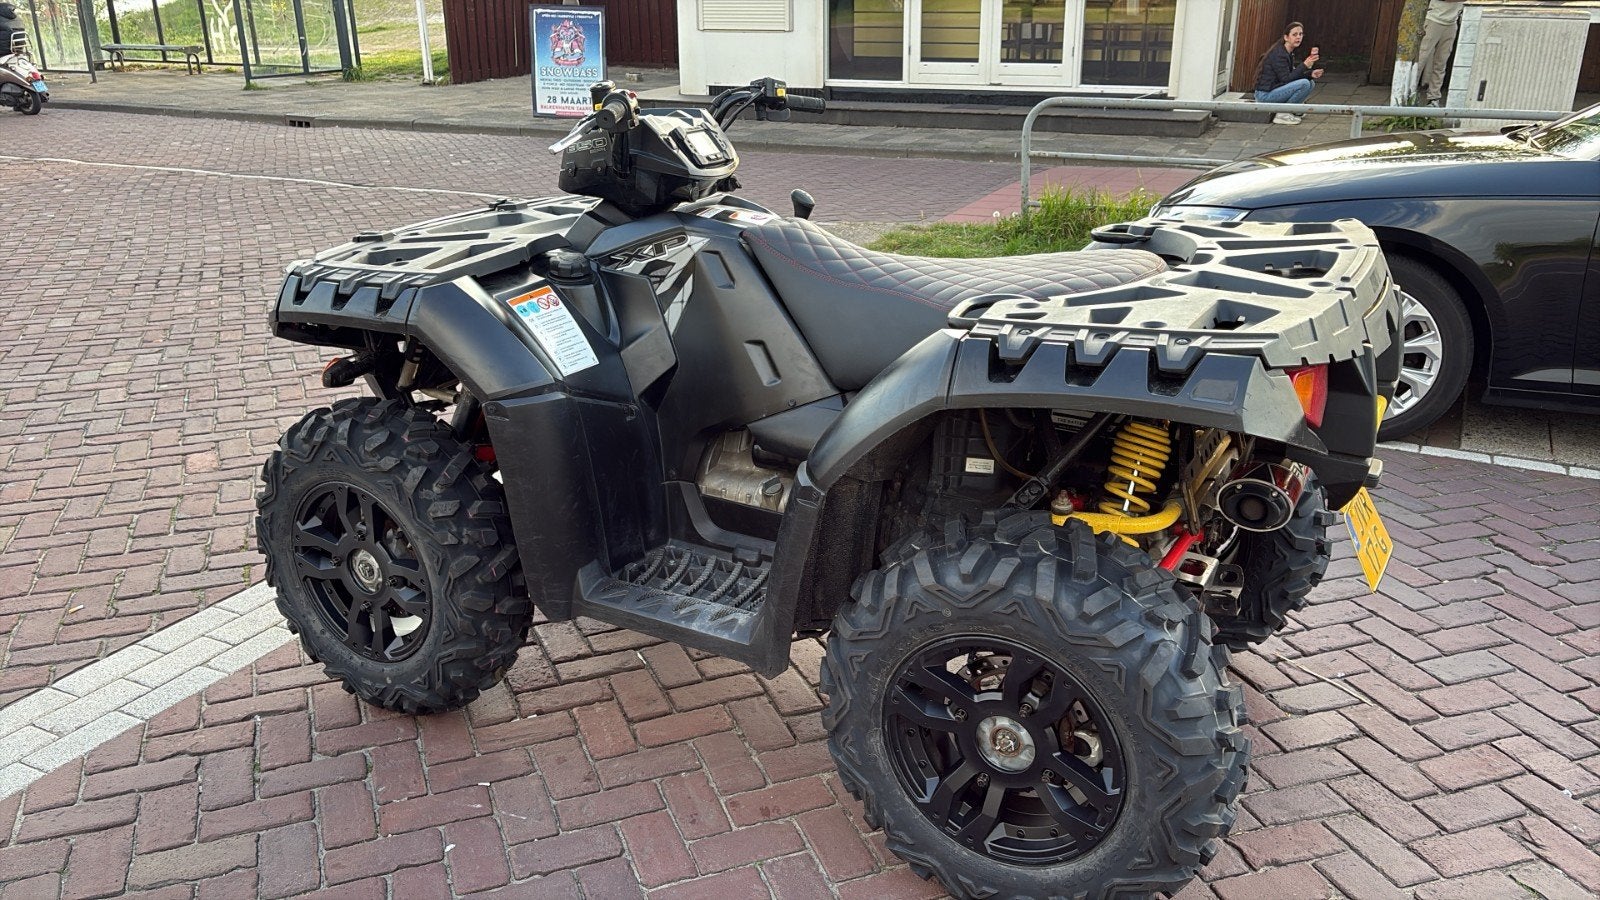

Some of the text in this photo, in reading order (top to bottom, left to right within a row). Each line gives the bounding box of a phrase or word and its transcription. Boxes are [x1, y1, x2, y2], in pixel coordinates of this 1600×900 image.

[540, 66, 598, 77] SNOWBASS
[547, 95, 592, 105] 28 MAART
[609, 234, 690, 271] XP
